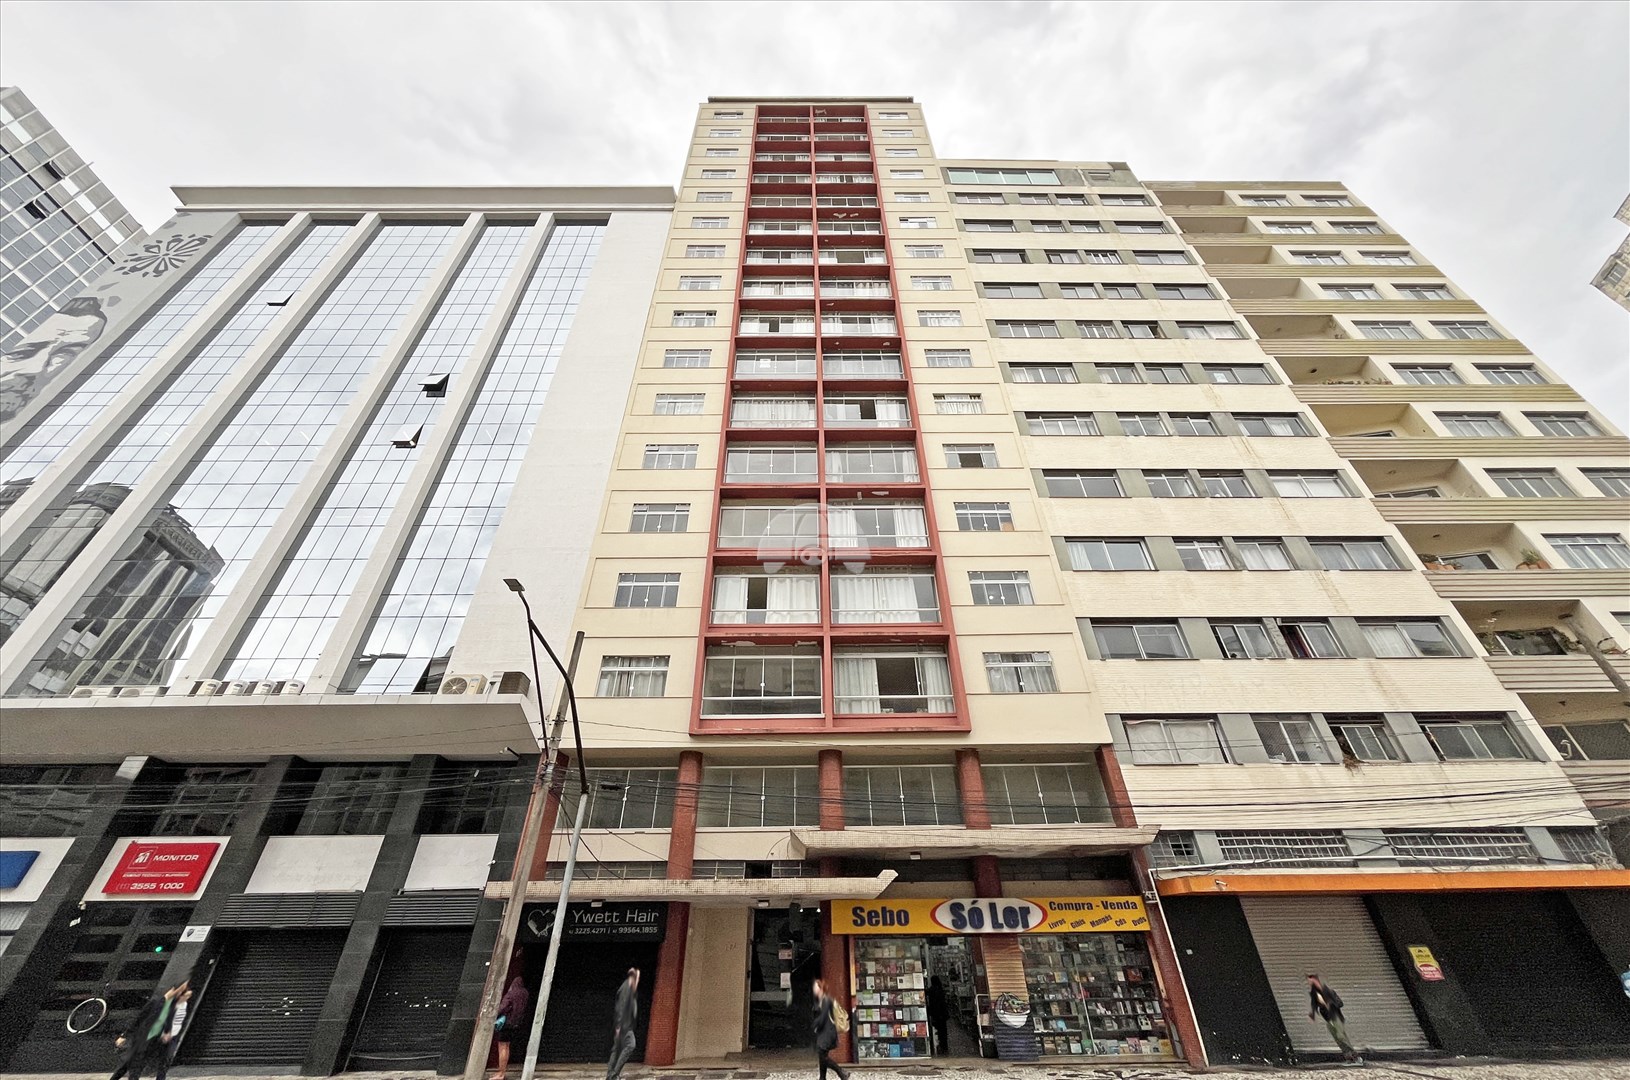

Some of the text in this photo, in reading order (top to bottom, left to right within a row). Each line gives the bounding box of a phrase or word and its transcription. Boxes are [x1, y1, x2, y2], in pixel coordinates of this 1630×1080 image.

[130, 882, 157, 890] 3555
[160, 882, 184, 890] 1000
[1048, 902, 1093, 911] Compra
[1101, 900, 1138, 910] Venda
[572, 909, 659, 924] Ywett Hair
[852, 906, 910, 926] Sebo
[950, 900, 1030, 930] Só Ler
[618, 926, 658, 934] 99564.1855
[1048, 918, 1066, 930] Livros
